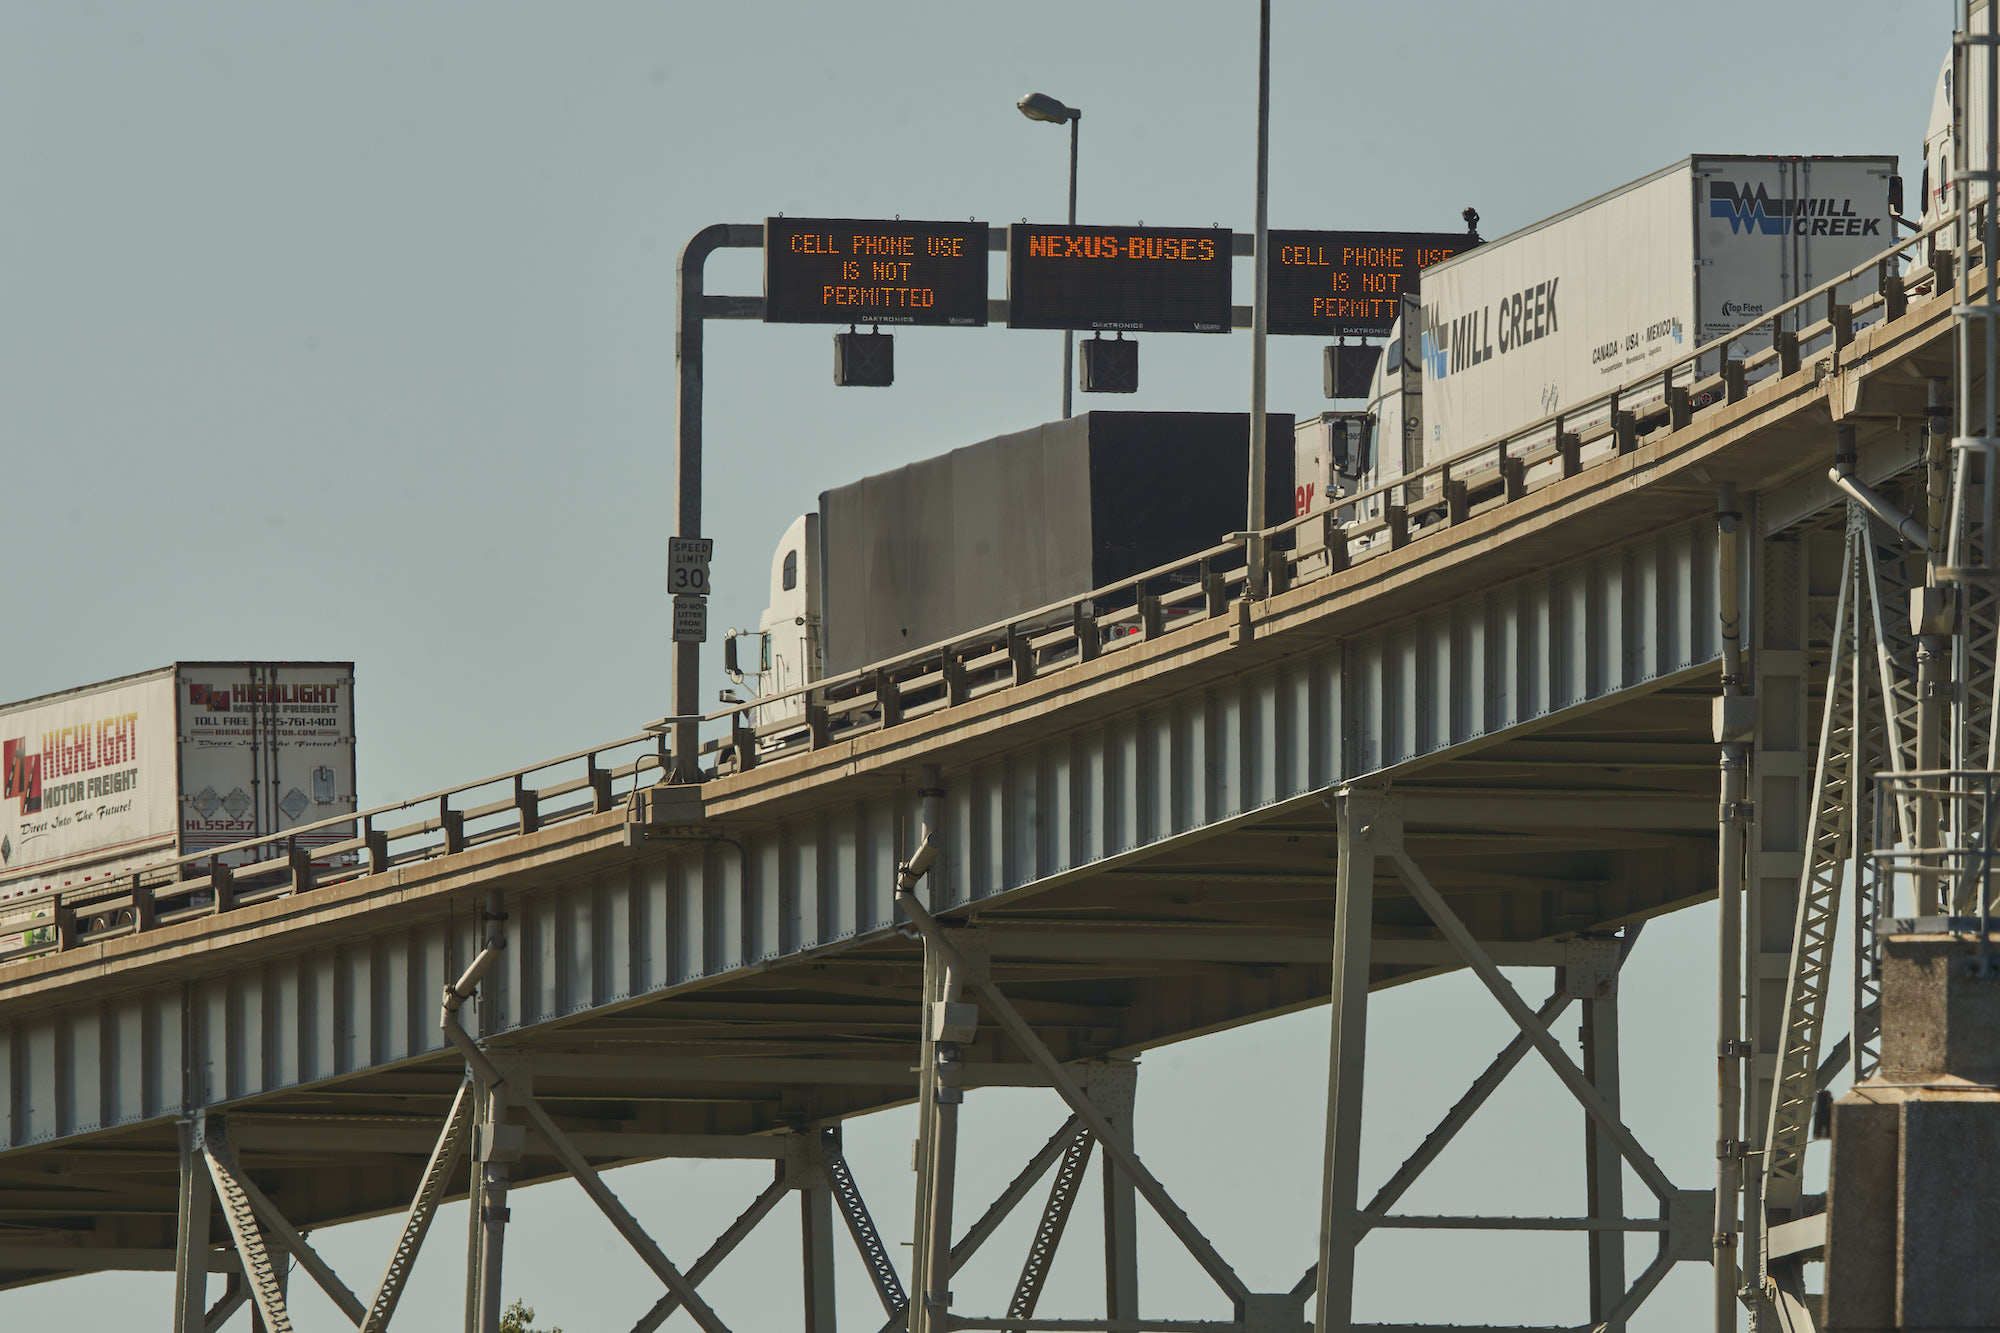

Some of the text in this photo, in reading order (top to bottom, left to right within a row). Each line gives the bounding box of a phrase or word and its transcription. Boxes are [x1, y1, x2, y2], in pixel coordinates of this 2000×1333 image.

[1796, 198, 1857, 217] MILL
[1794, 218, 1881, 236] CREEK
[791, 234, 964, 257] CELL PHONE USE
[1029, 235, 1215, 261] NEXUS-BUSES
[1281, 246, 1454, 268] CELL PHONE USE
[843, 261, 912, 281] IS NOT
[1332, 272, 1401, 293] IS NOT
[823, 285, 934, 307] PERMITTED
[1313, 297, 1399, 318] PERMITT
[862, 315, 914, 323] DAKTRONICS
[1092, 321, 1144, 329] DAKTRONICS
[1450, 276, 1560, 376] MILL CREEK
[1343, 327, 1392, 335] DAKTRONIC
[1592, 318, 1671, 365] CANADA USA MEXICO
[674, 542, 708, 553] SPEED
[676, 554, 704, 564] LIMIT
[675, 567, 704, 588] 30
[232, 684, 339, 703] HIGHLIGHT
[282, 704, 339, 713] FREIGHT
[194, 716, 219, 726] TOLL
[223, 716, 249, 726] FREE
[215, 729, 317, 737] HIGHLIGTMTOR.COM
[42, 711, 138, 780] HIGHLIGHT
[43, 767, 138, 810] MOTOR FREIGHT
[20, 798, 132, 836] Direct Into The Future!
[185, 819, 255, 831] HL55237
